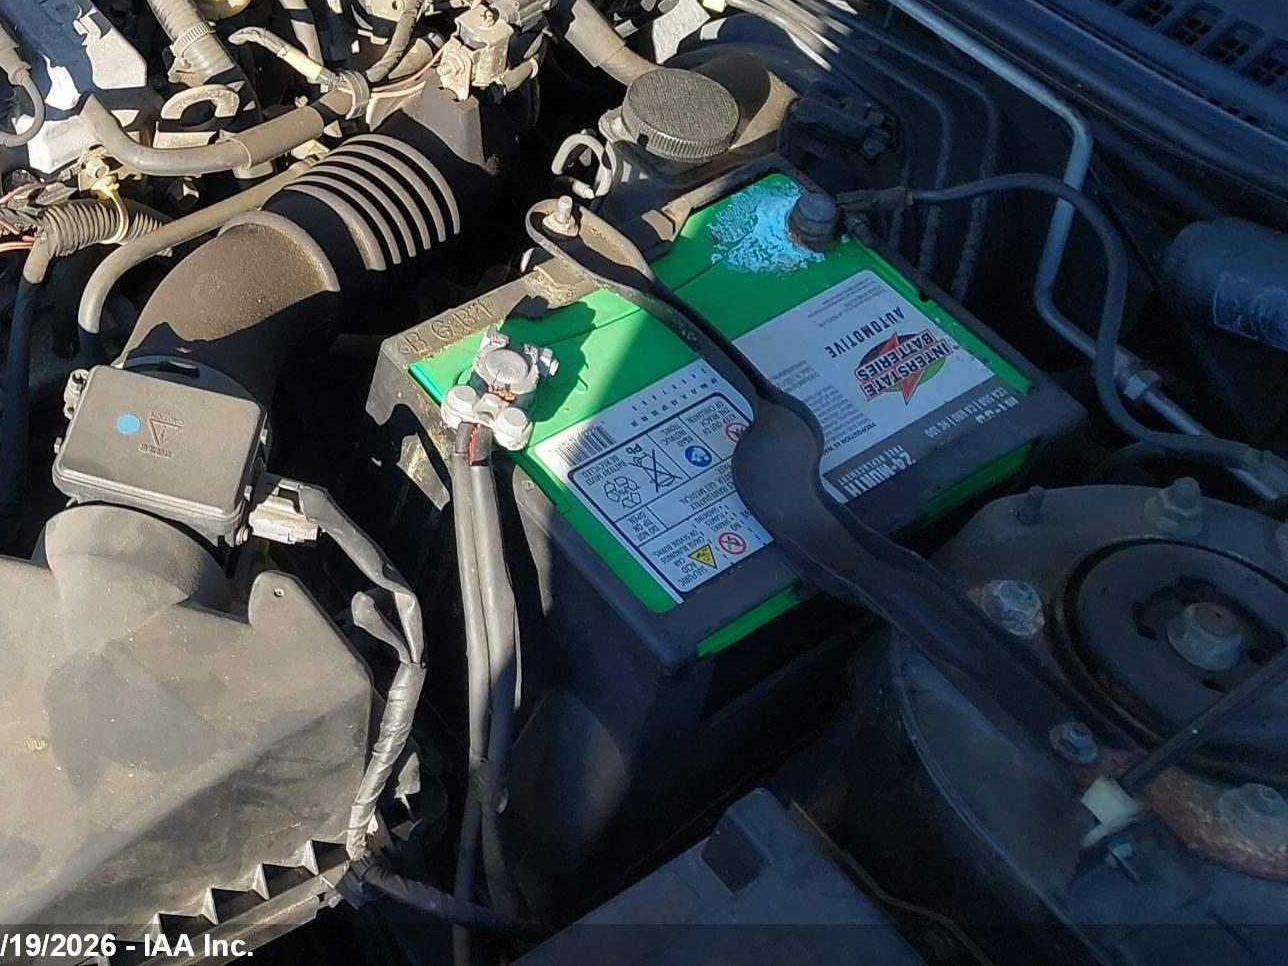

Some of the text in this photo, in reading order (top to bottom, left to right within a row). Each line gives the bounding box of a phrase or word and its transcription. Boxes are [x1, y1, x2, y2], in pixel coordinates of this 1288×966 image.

[822, 306, 907, 359] AUTOMOTIVE
[854, 331, 936, 381] BATTERIES
[861, 340, 952, 396] INTERSTATE
[624, 441, 642, 458] Pb
[584, 460, 627, 486] BATTERY MUST
[843, 450, 917, 498] 24-MONTH
[635, 524, 660, 541] DO NOT
[672, 557, 686, 567] CAN
[679, 560, 698, 573] ACID
[676, 565, 708, 586] SULFURIC
